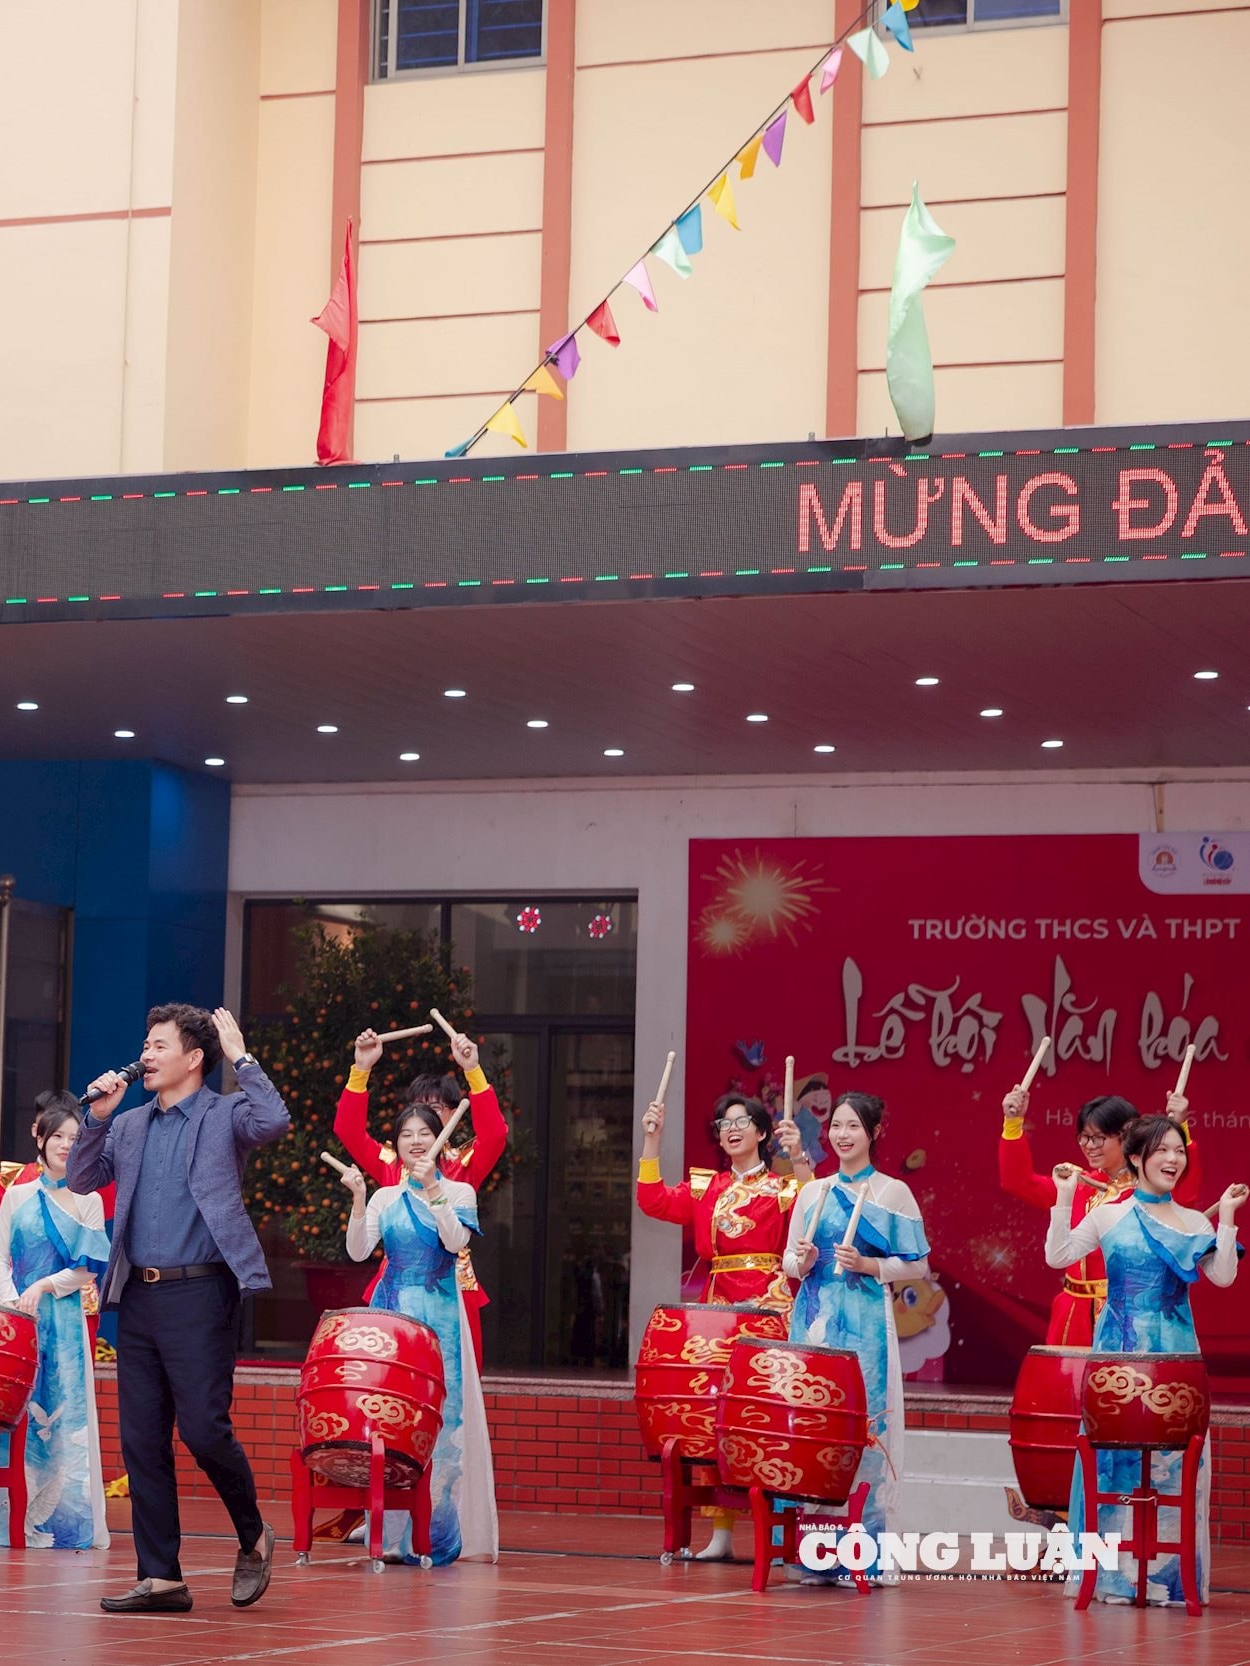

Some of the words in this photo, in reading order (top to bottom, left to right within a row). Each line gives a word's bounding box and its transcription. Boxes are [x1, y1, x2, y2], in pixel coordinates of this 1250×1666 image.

[798, 462, 1081, 552] MỪNG
[908, 913, 1027, 940] TRƯỜNG
[1035, 917, 1110, 940] THCS
[1117, 912, 1158, 939] VÀ
[1165, 917, 1241, 939] THPT
[1046, 1107, 1073, 1126] Hà
